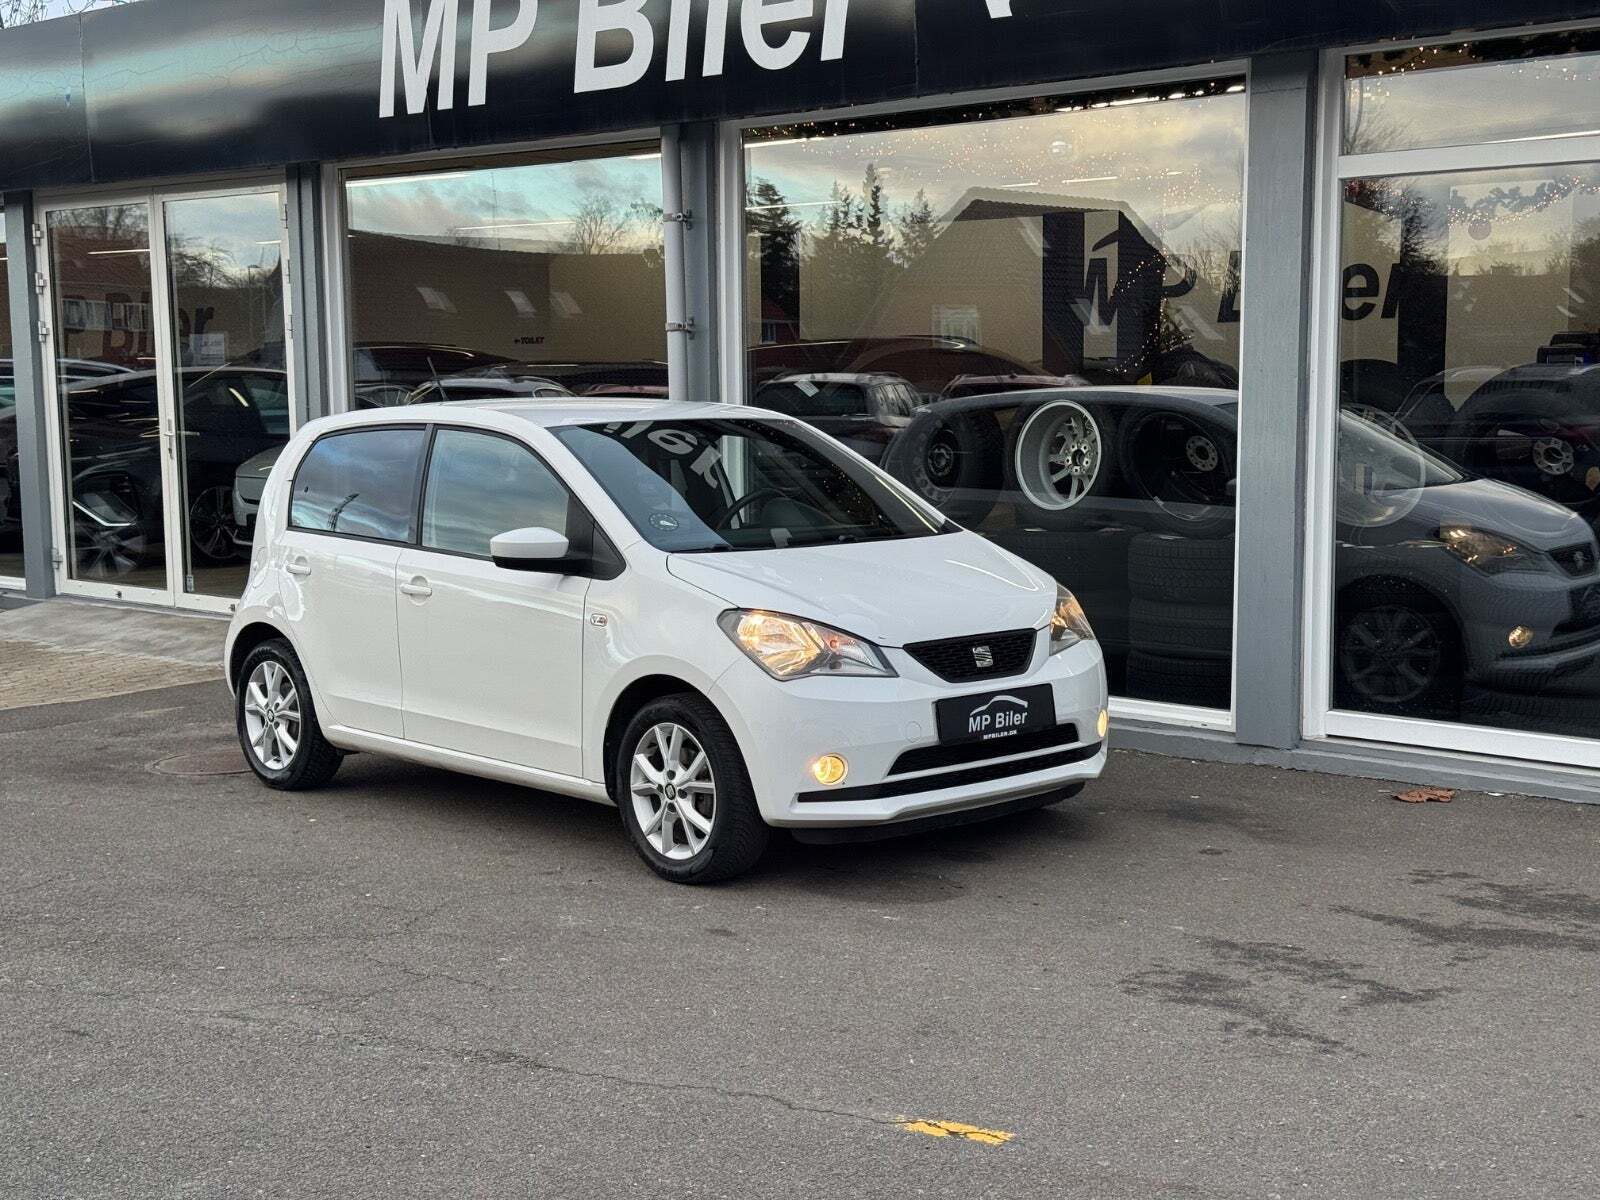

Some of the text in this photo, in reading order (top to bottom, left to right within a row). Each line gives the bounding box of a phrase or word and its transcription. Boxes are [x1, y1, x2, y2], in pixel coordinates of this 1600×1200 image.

[379, 0, 851, 118] MP Biler
[968, 710, 1028, 733] MP Biler
